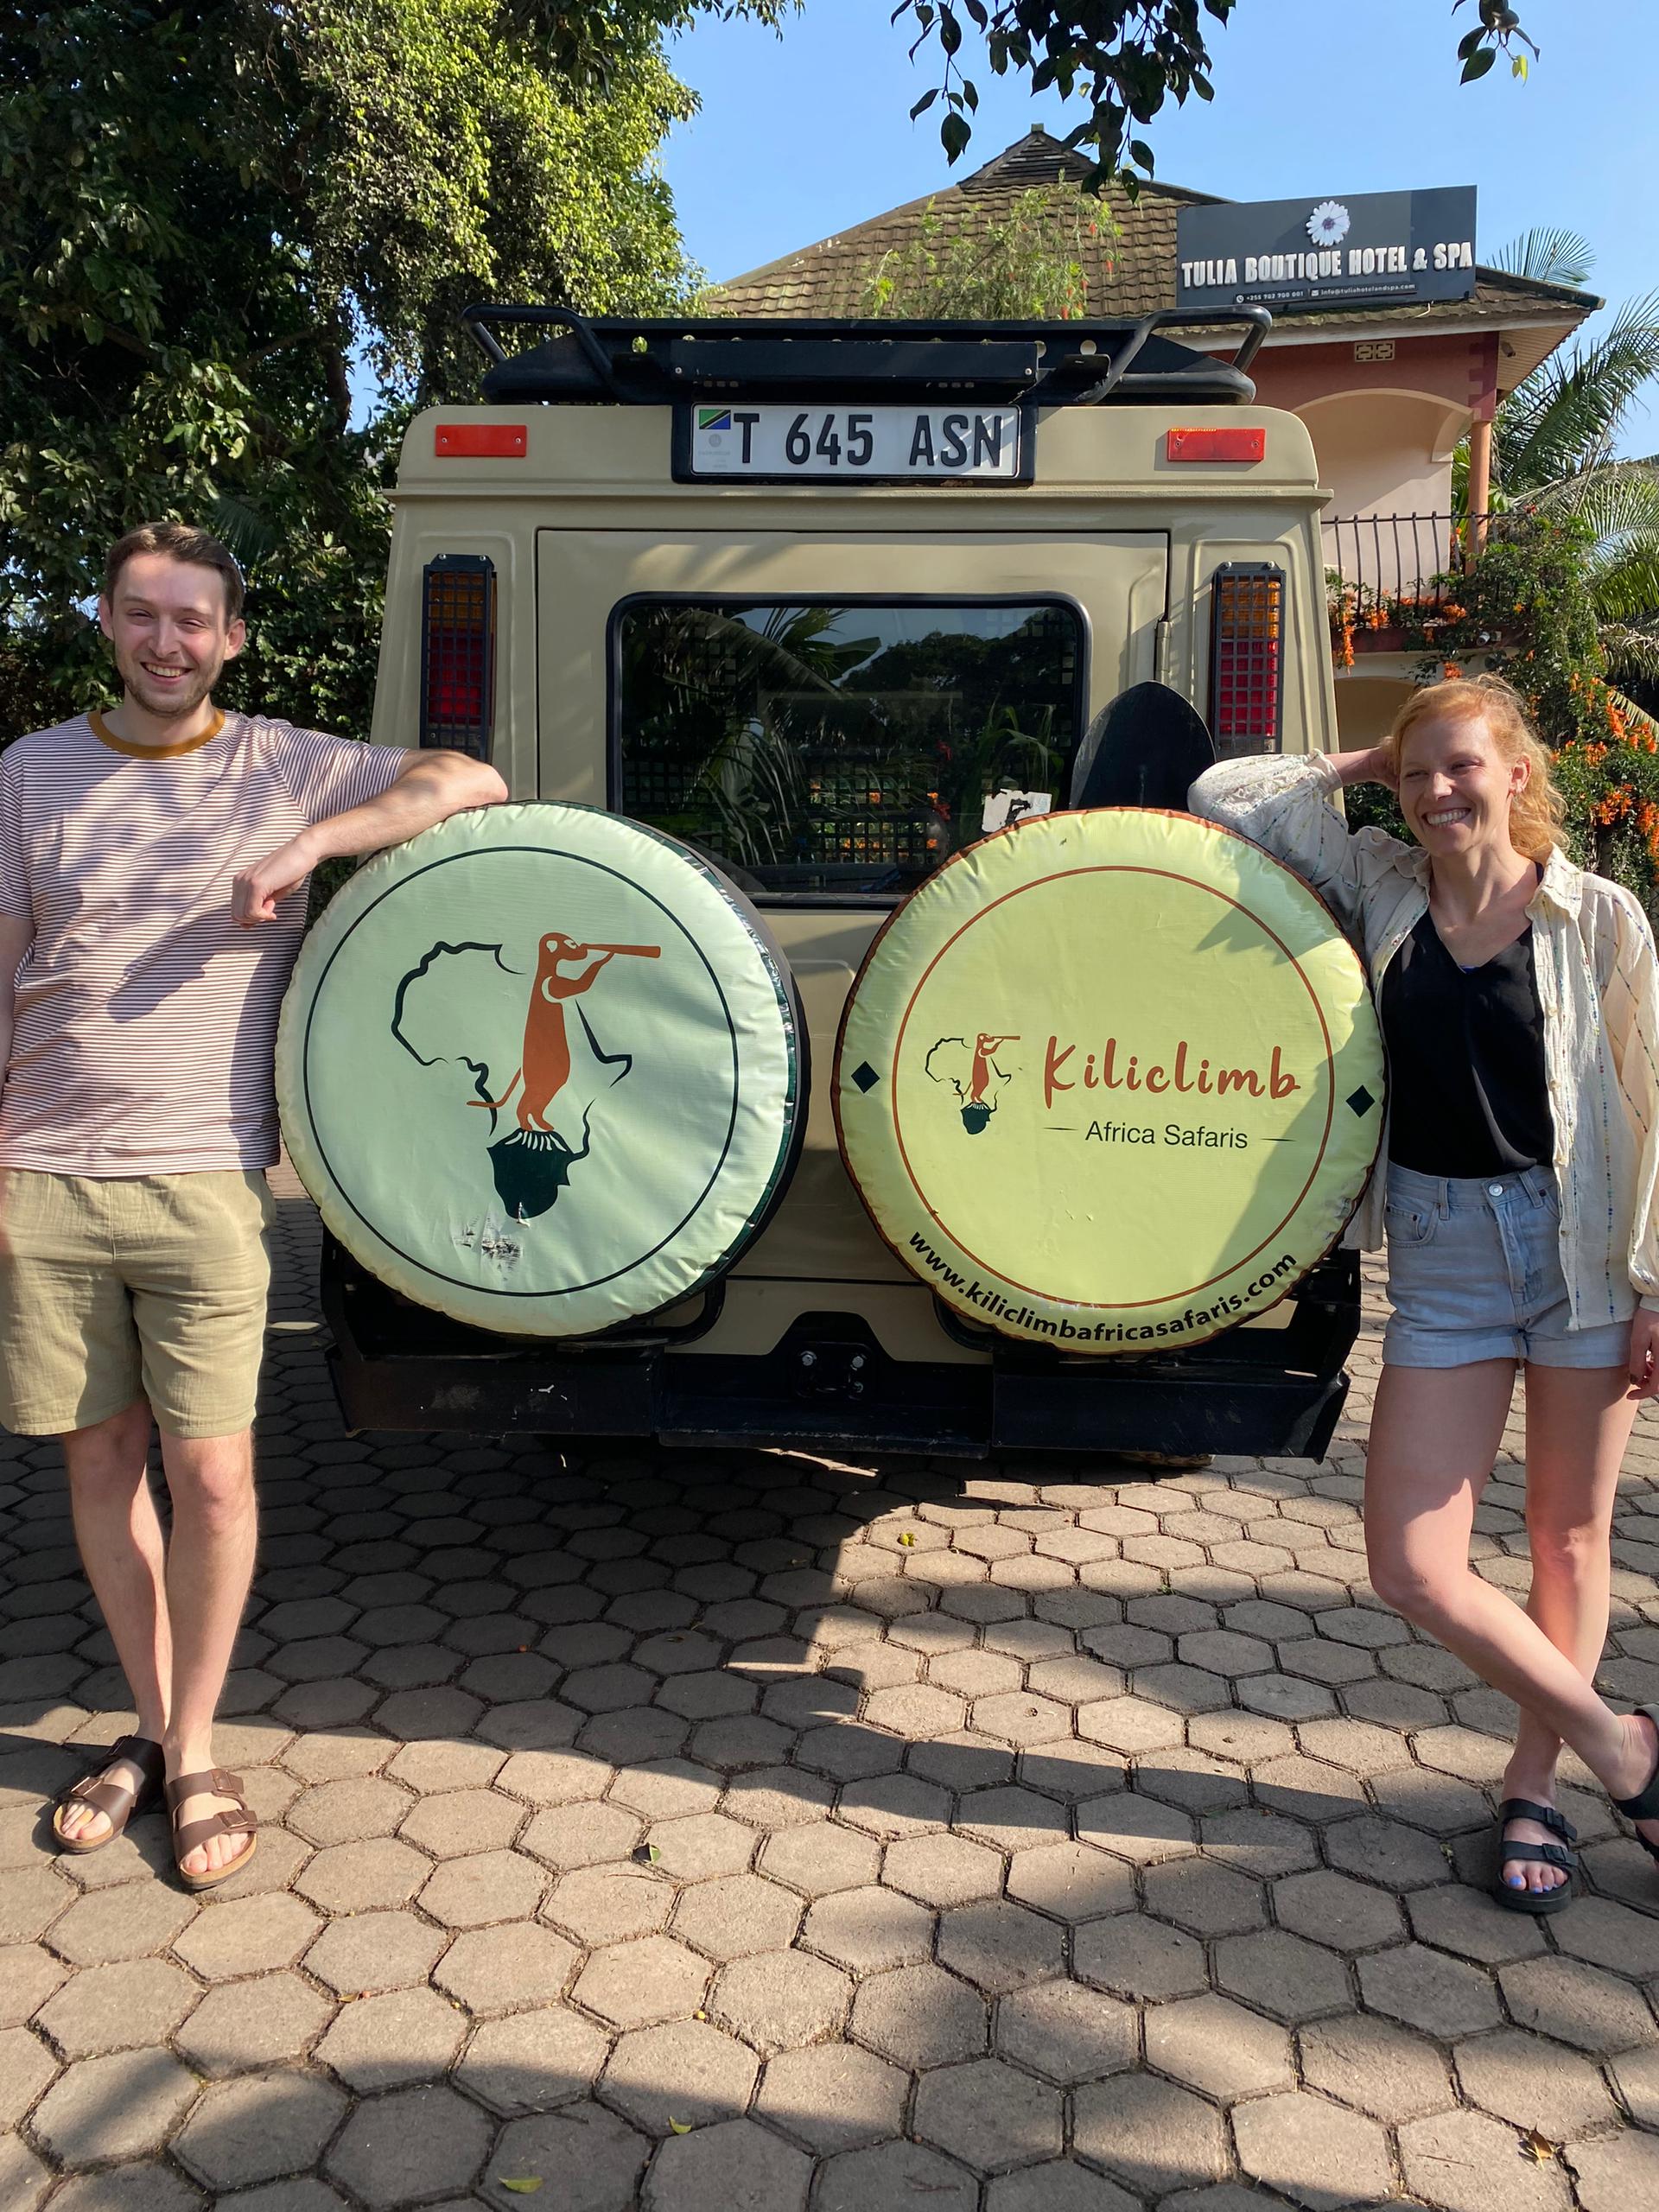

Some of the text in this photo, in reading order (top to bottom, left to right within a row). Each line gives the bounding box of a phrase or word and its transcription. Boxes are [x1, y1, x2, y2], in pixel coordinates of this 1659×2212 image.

[1181, 241, 1473, 289] TULIA BOUTIQUE HOTEL & SPA
[734, 413, 1002, 467] T 645 ASN
[1044, 1036, 1301, 1109] Kiliclimb
[1085, 1121, 1249, 1149] Africa Safaris
[908, 1231, 1297, 1342] www.kiliclimbafricasafaris.com
